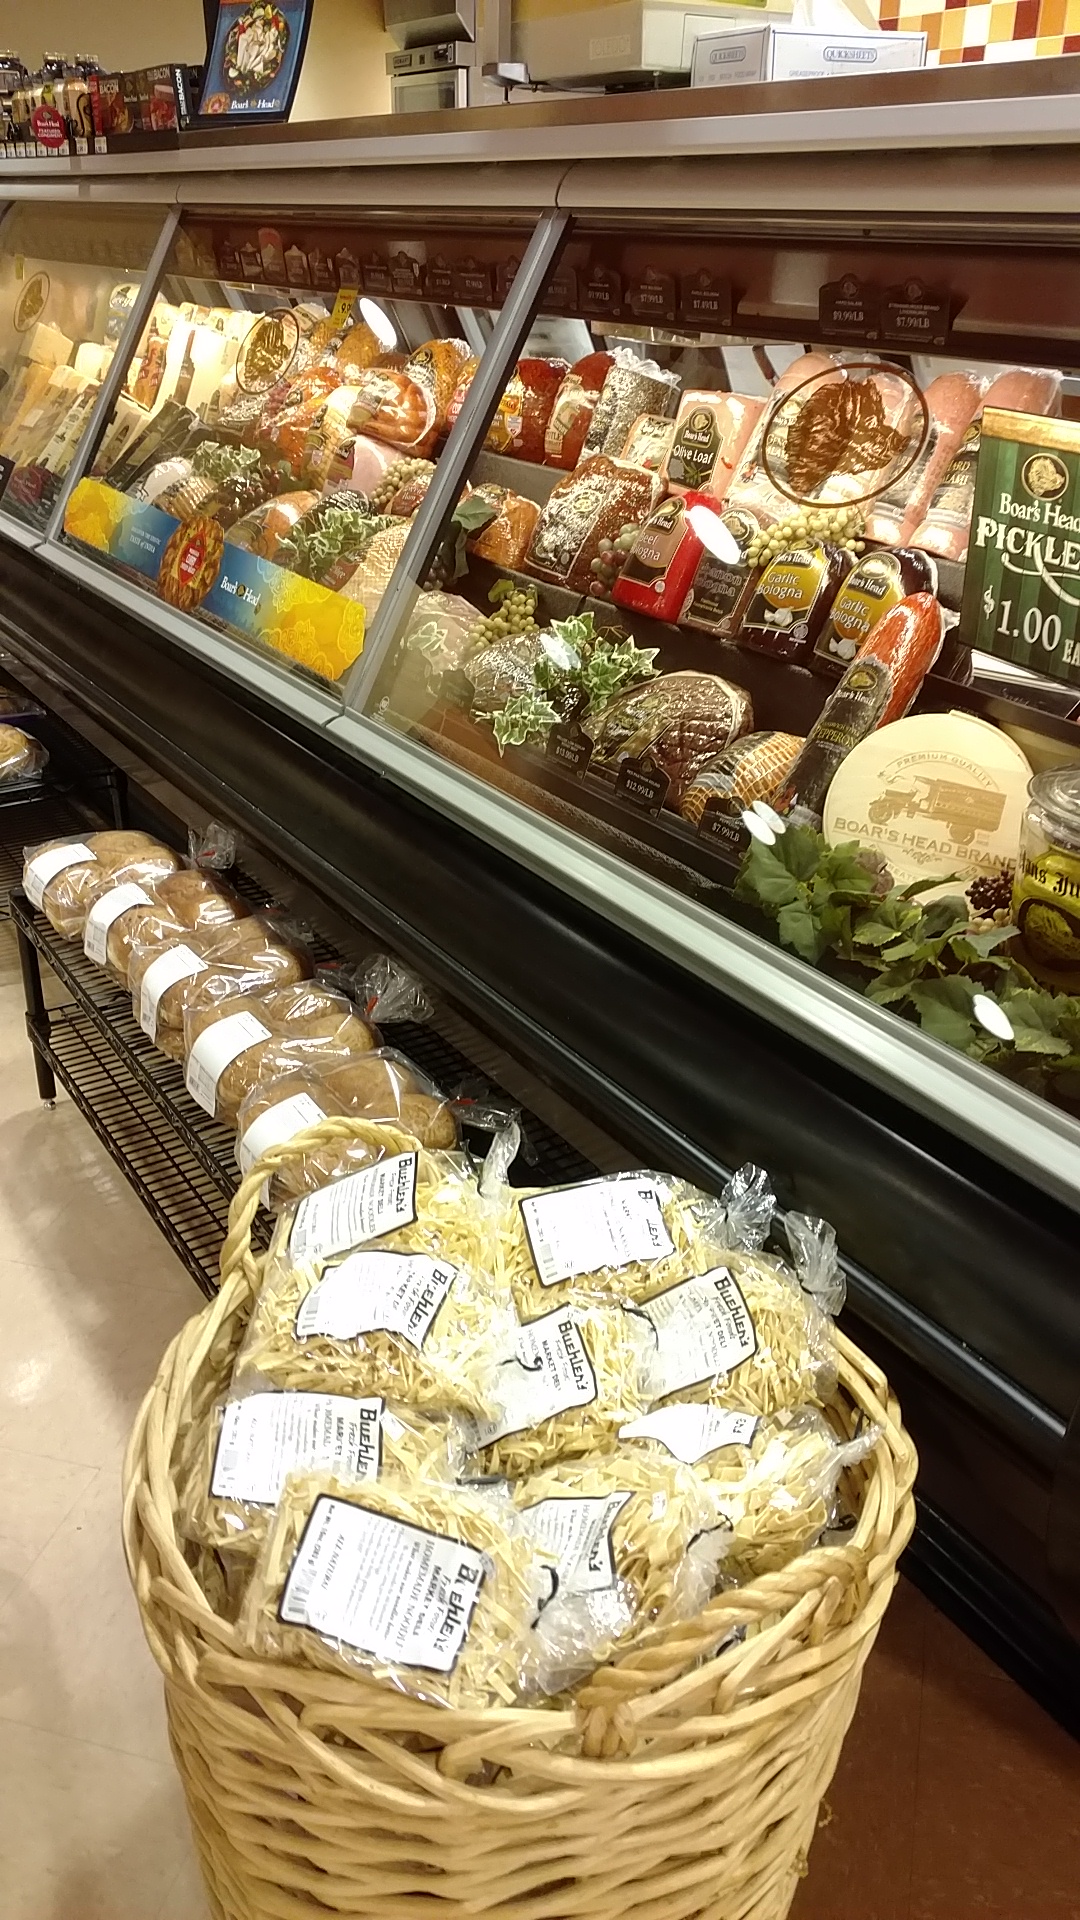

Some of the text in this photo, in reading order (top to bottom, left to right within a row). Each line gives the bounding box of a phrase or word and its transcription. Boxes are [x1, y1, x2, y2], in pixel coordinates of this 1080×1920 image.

[827, 49, 875, 61] QUICKSHEETS
[154, 67, 170, 80] BACON
[99, 79, 119, 94] BACON
[175, 68, 185, 103] BACON
[833, 311, 864, 321] $9.99/LB
[673, 445, 714, 465] Olive Loaf
[1000, 492, 1041, 523] Boar's
[767, 571, 800, 585] Garlic
[865, 579, 886, 596] Head
[243, 587, 261, 606] Head
[757, 584, 803, 600] Bologna
[840, 596, 870, 616] Garlic
[983, 585, 1062, 652] $1.00
[814, 725, 857, 749] PEPPERON
[896, 753, 993, 788] PREMIUM QUALITY
[626, 780, 654, 798] $12.99/LB
[712, 822, 740, 842] $7.99/LB
[834, 817, 899, 842] BOAR'S
[902, 833, 952, 855] HEAD
[396, 1157, 413, 1213] Buehler's
[714, 1276, 750, 1348] Buehler's
[717, 1330, 728, 1348] DELI
[542, 1340, 557, 1373] MARKET
[558, 1320, 588, 1390] Buehler's
[411, 1540, 435, 1604] HOMEMADE
[424, 1565, 442, 1610] MARKET
